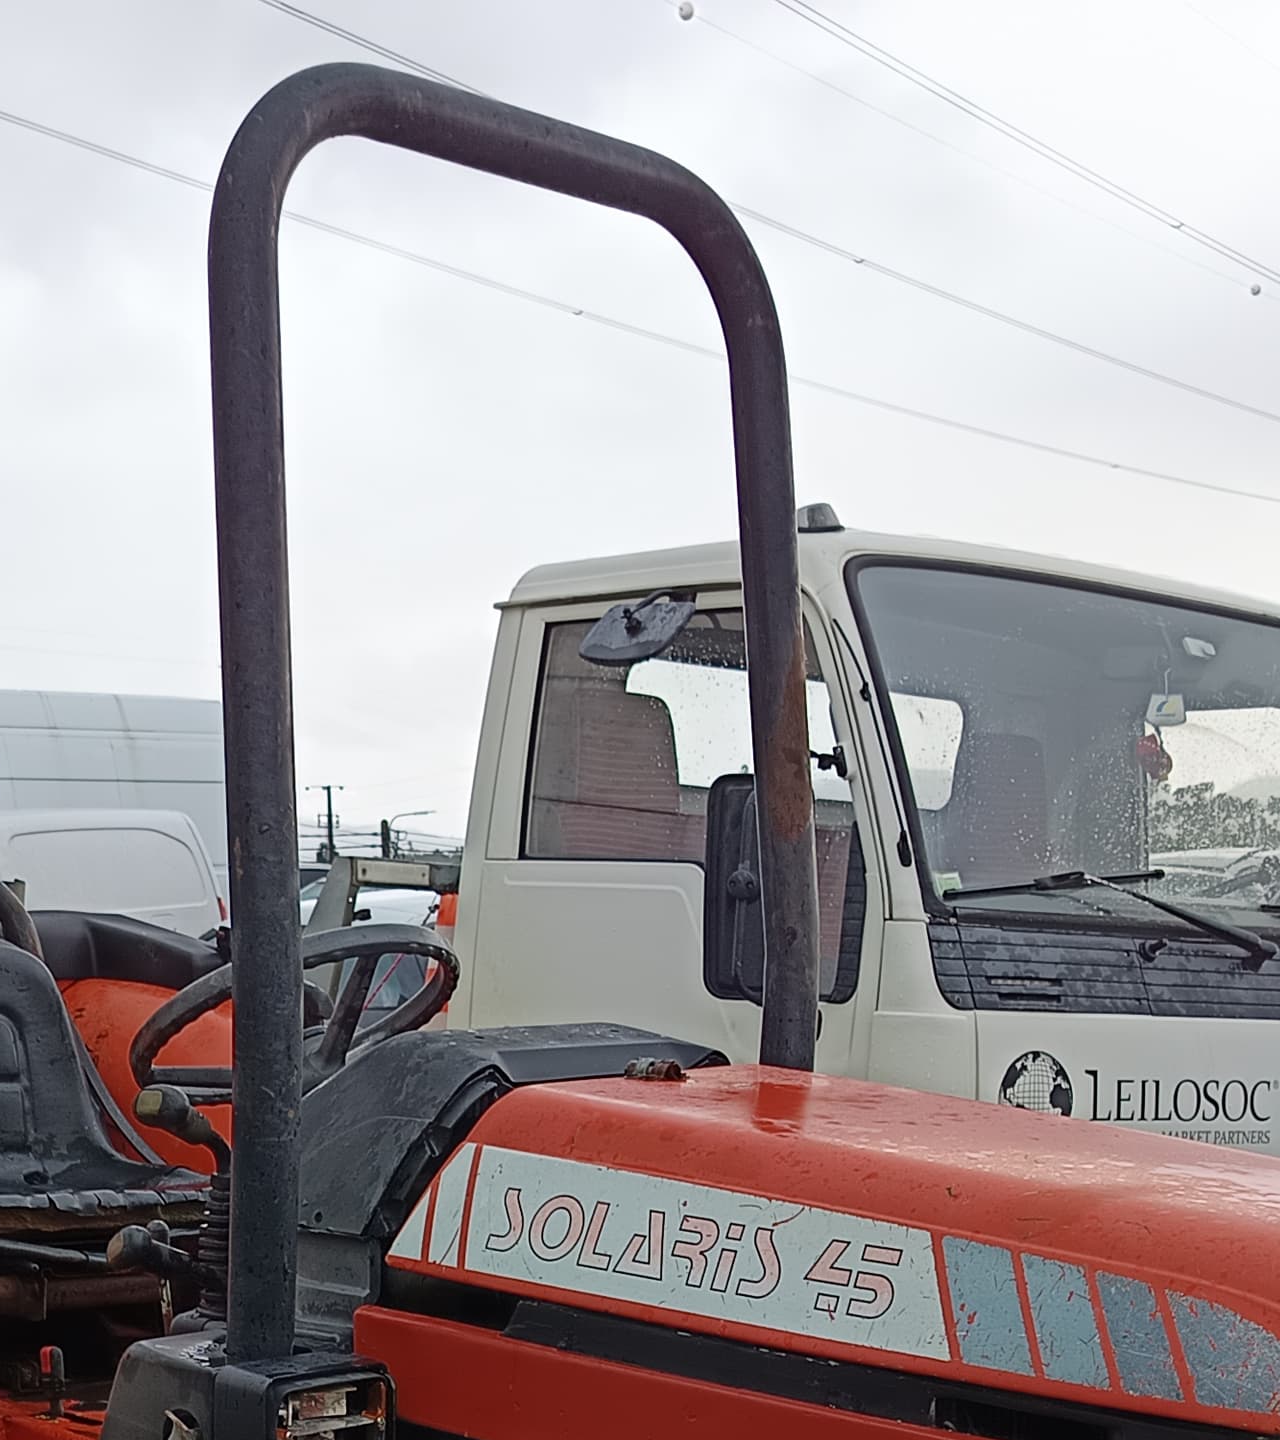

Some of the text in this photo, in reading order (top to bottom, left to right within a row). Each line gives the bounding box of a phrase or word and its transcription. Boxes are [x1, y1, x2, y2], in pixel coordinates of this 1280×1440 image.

[1084, 1069, 1272, 1122] LEILOSOC
[1213, 1130, 1271, 1145] PARTNERS
[803, 1238, 904, 1319] 45
